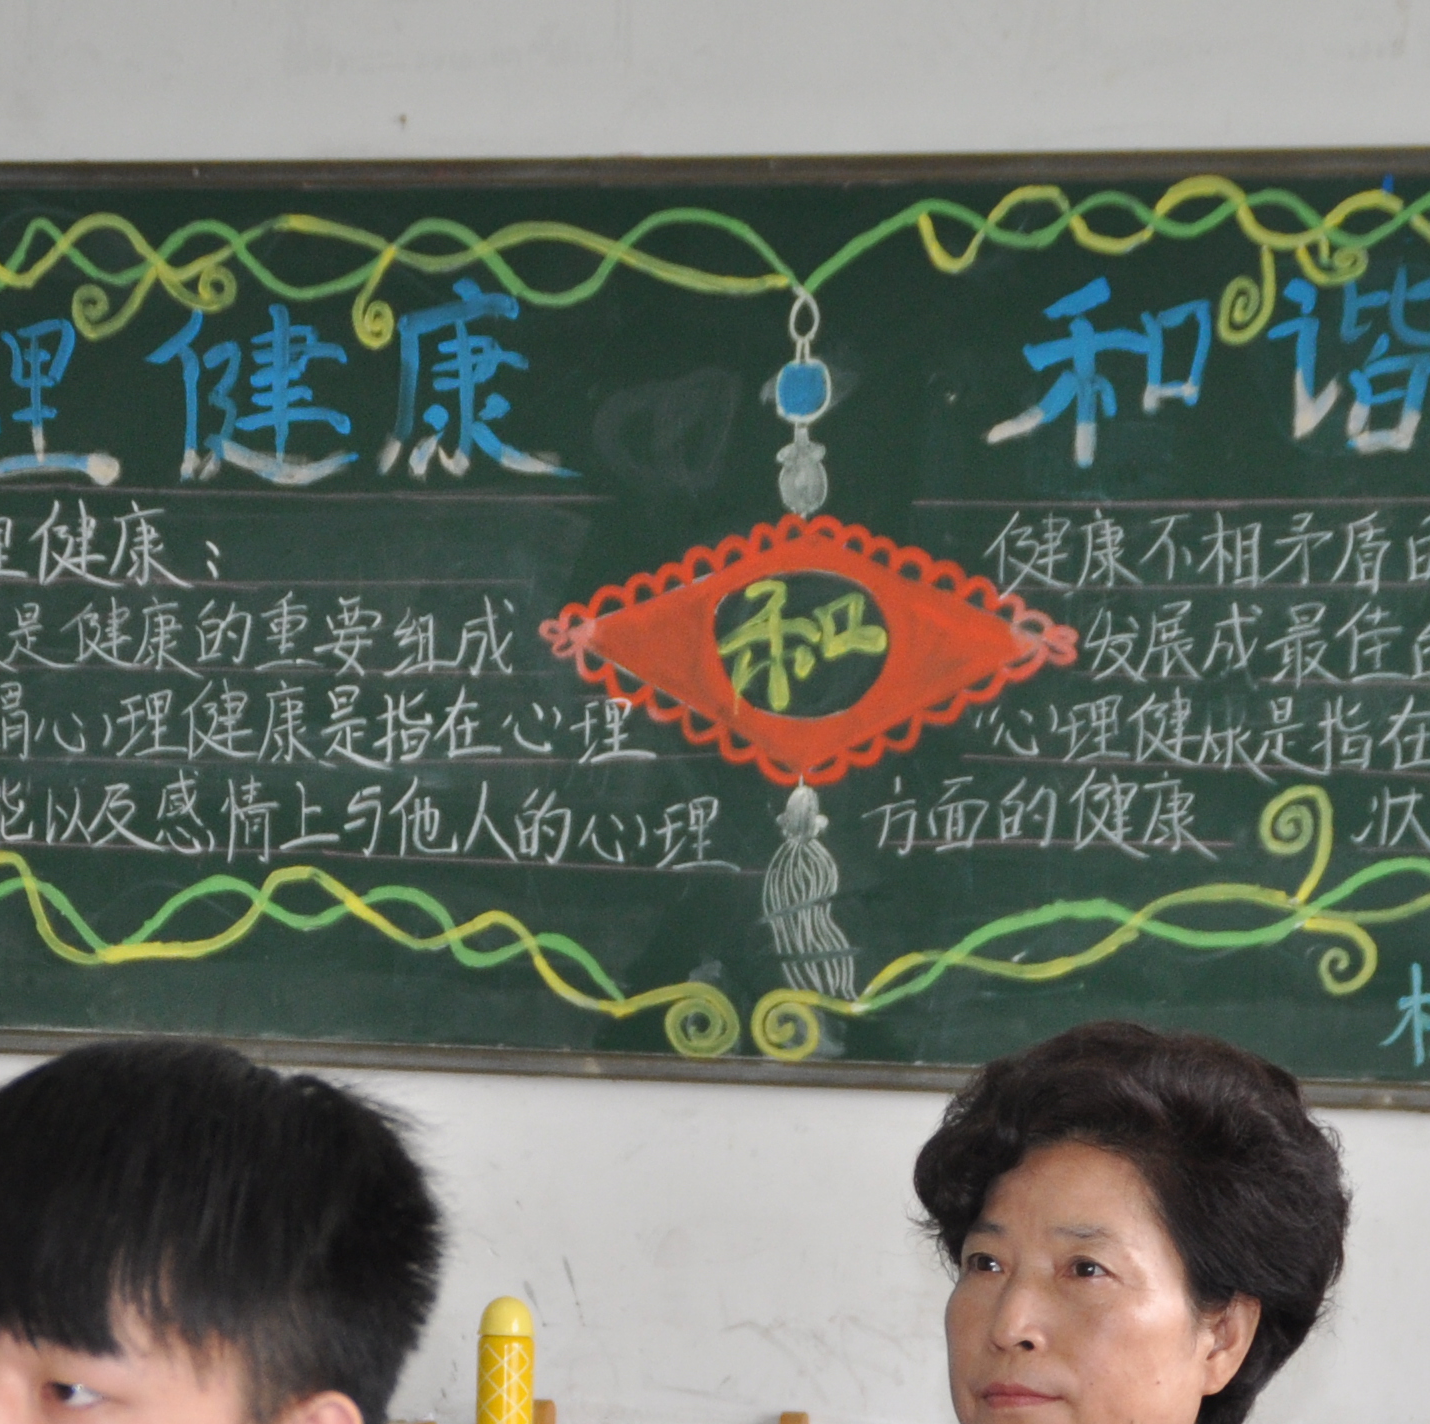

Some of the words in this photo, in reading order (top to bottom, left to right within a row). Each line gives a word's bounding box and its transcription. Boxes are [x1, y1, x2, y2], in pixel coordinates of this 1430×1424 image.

[717, 579, 889, 713] 和
[862, 767, 1217, 862] 方面的健康
